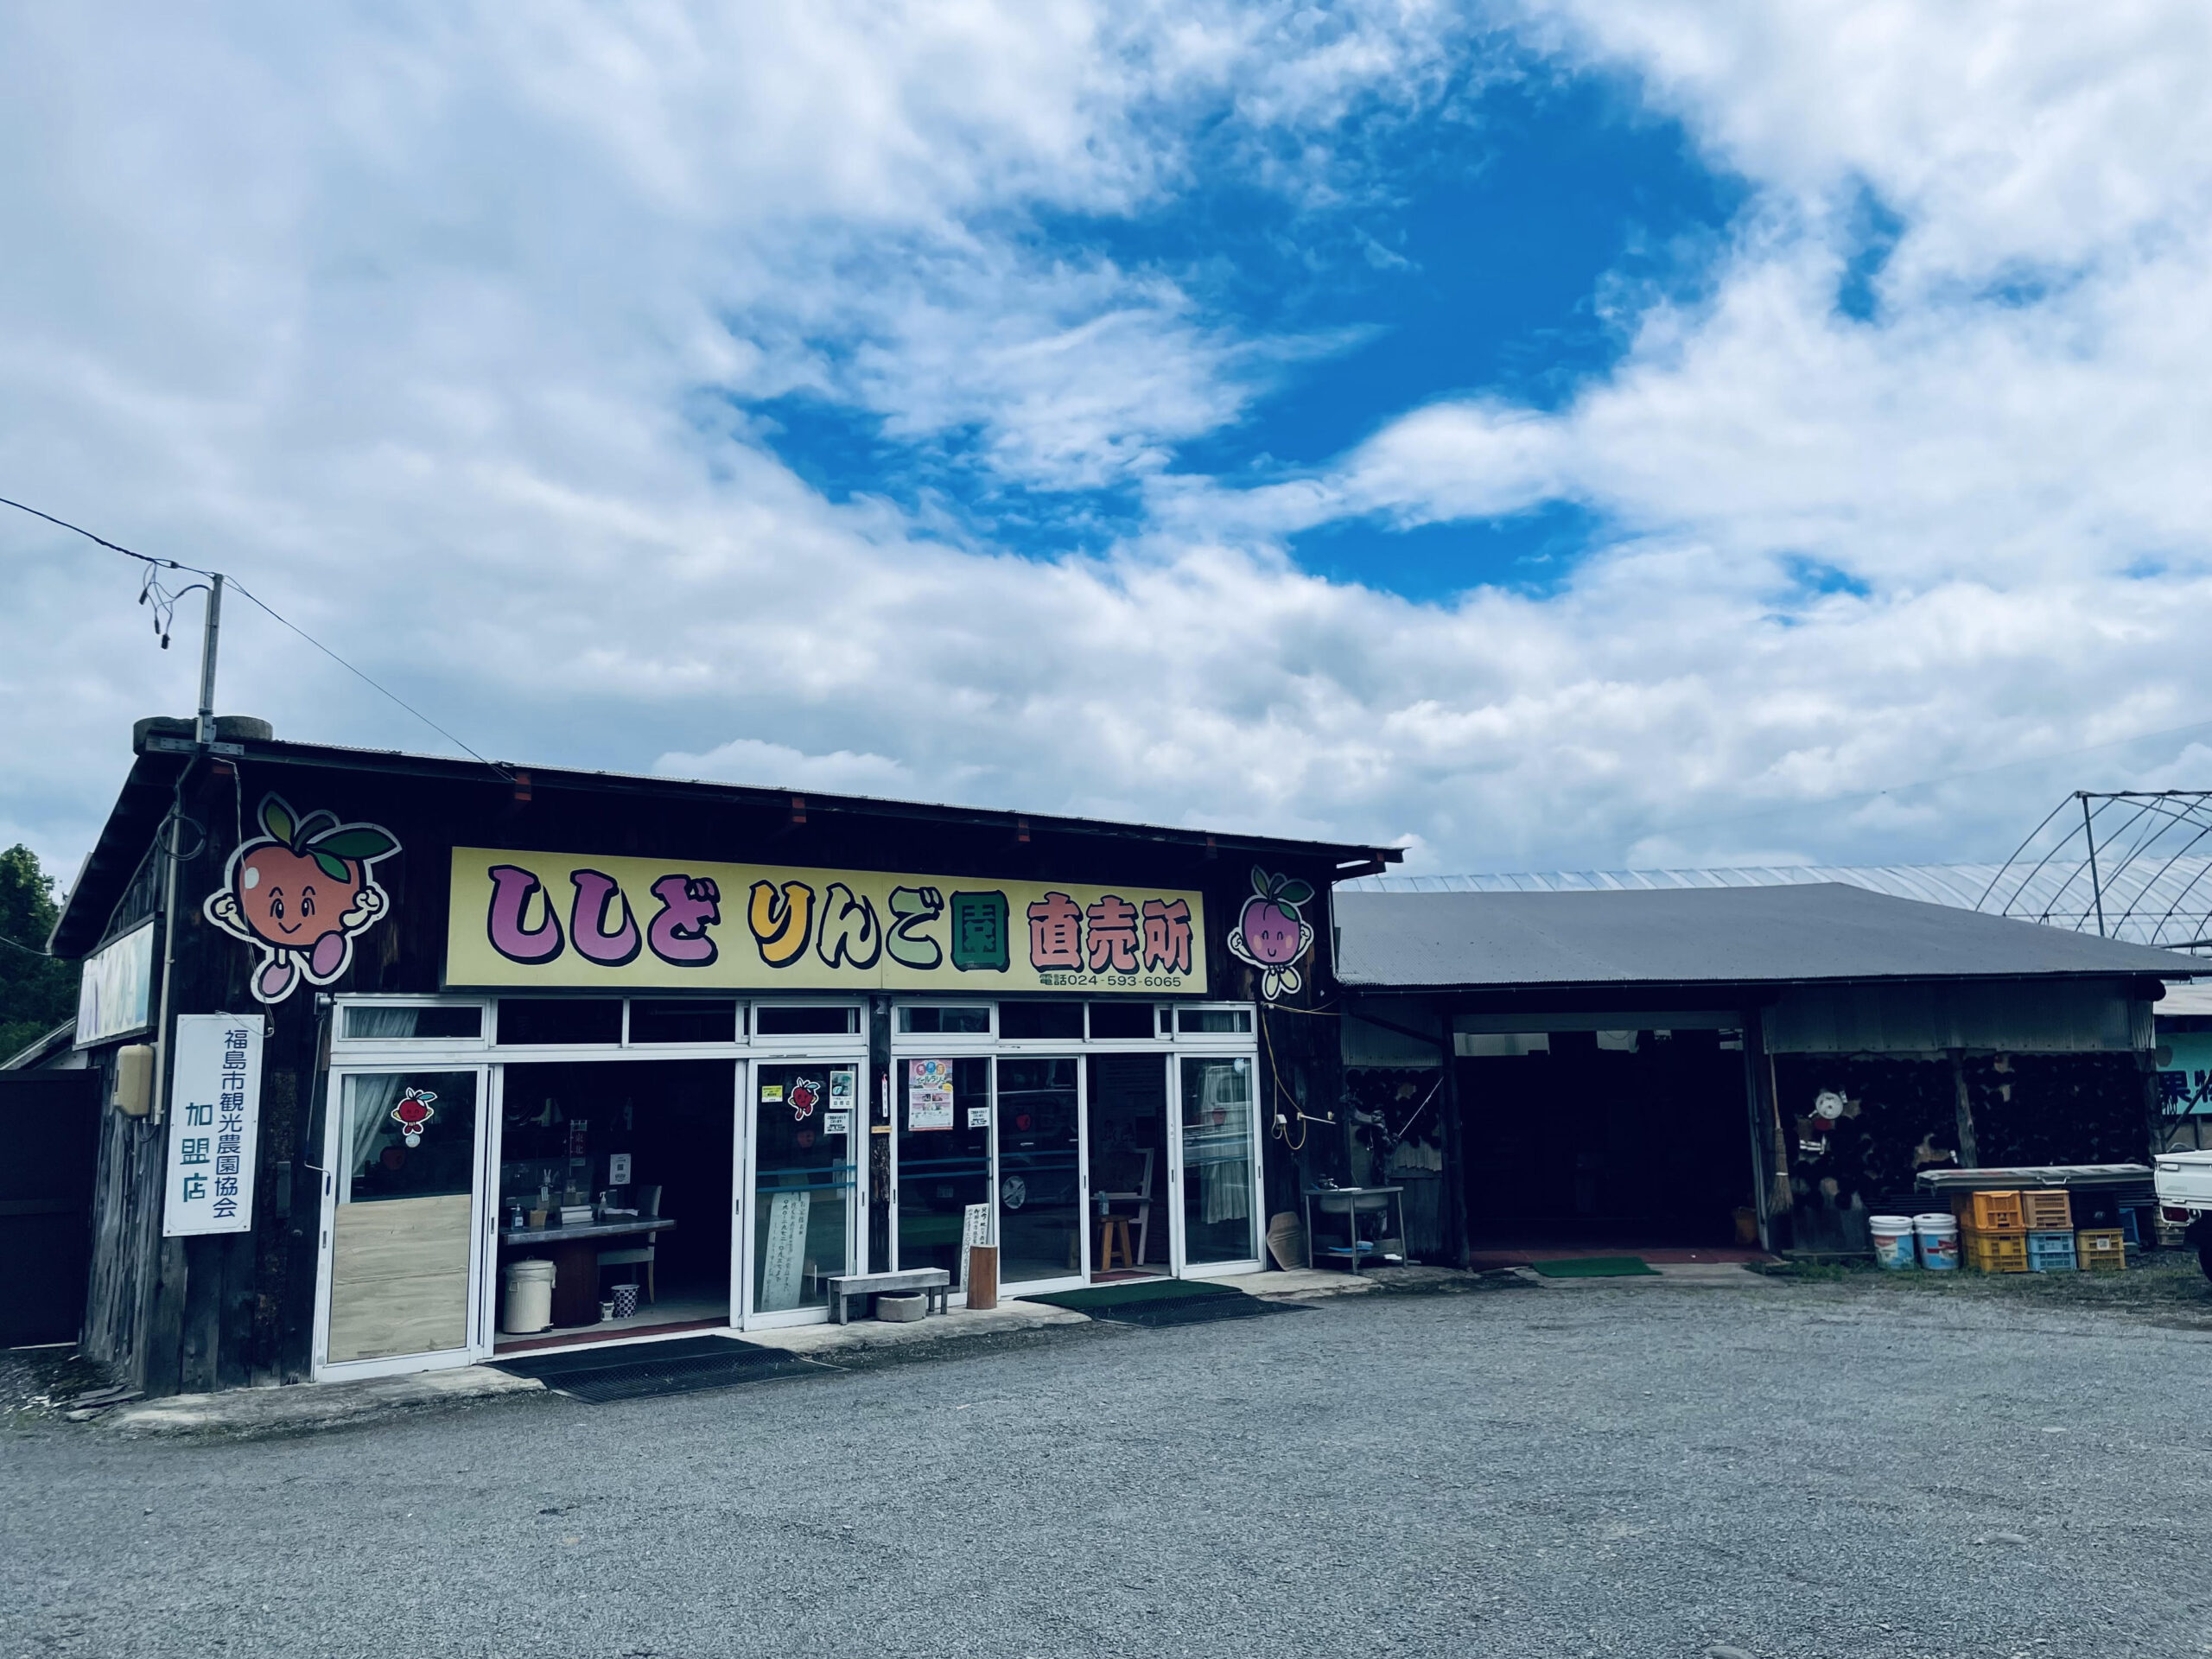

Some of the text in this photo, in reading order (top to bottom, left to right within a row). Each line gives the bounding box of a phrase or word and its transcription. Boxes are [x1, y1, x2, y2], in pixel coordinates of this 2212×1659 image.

[486, 864, 1194, 976] ししど りんご園 直売所
[180, 1102, 213, 1202] 加盟店
[213, 1029, 249, 1218] 福島市観光農園協会
